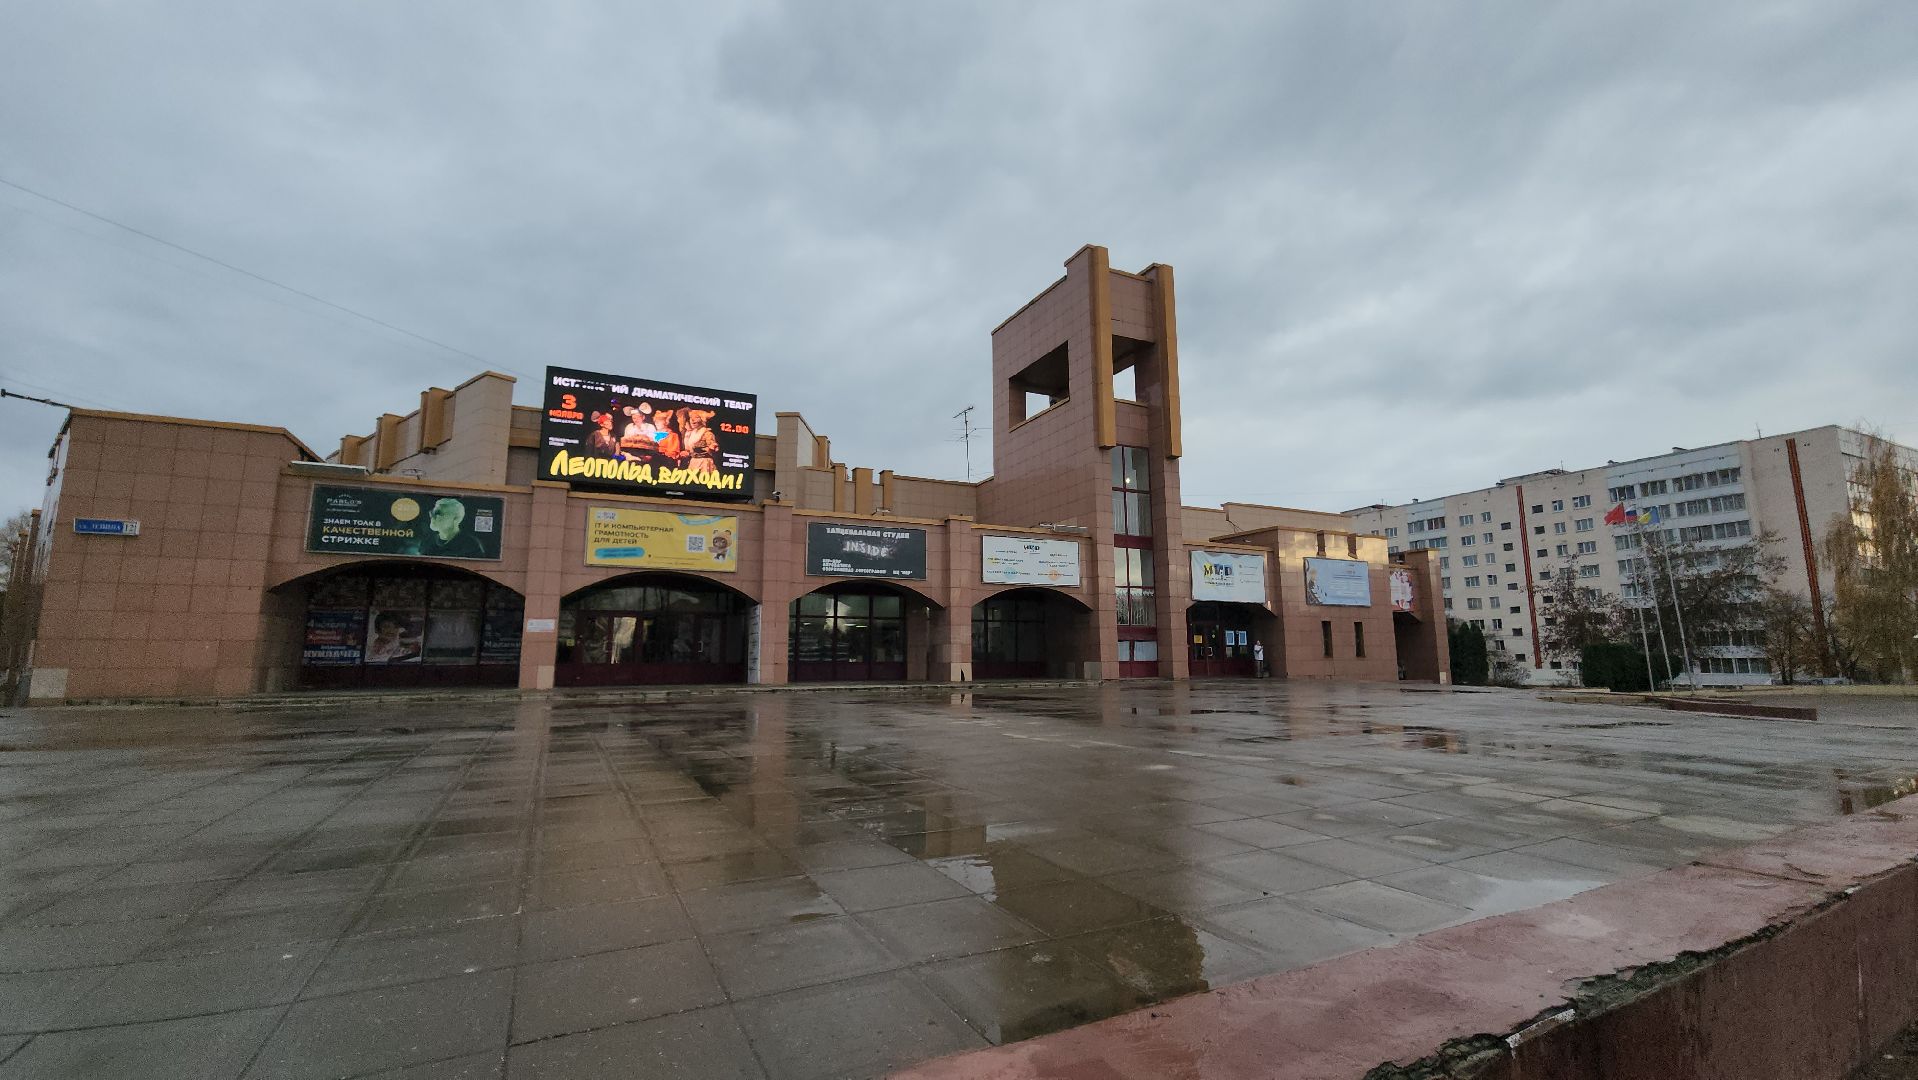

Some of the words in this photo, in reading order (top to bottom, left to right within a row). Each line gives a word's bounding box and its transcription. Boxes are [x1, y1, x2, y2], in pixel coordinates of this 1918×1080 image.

[561, 394, 577, 410] 3
[631, 386, 721, 407] ДРАМАТИЧЕСКИЙ
[724, 399, 753, 411] ТЕАТР
[720, 422, 750, 434] 12.00
[323, 518, 351, 526] ЗНАЕМ
[353, 519, 374, 527] ТОЛК
[611, 523, 674, 533] КОМПЬЮТЕРНАЯ
[322, 526, 414, 538] КАЧЕСТВЕННОЙ
[594, 530, 649, 539] ГРАМОТНОСТЬ
[826, 527, 880, 537] ТАНЦЕВАЛЬНАЯ
[883, 531, 910, 540] СТУДИЯ
[321, 535, 379, 546] СТРИЖКЕ
[594, 537, 610, 545] ДЛЯ
